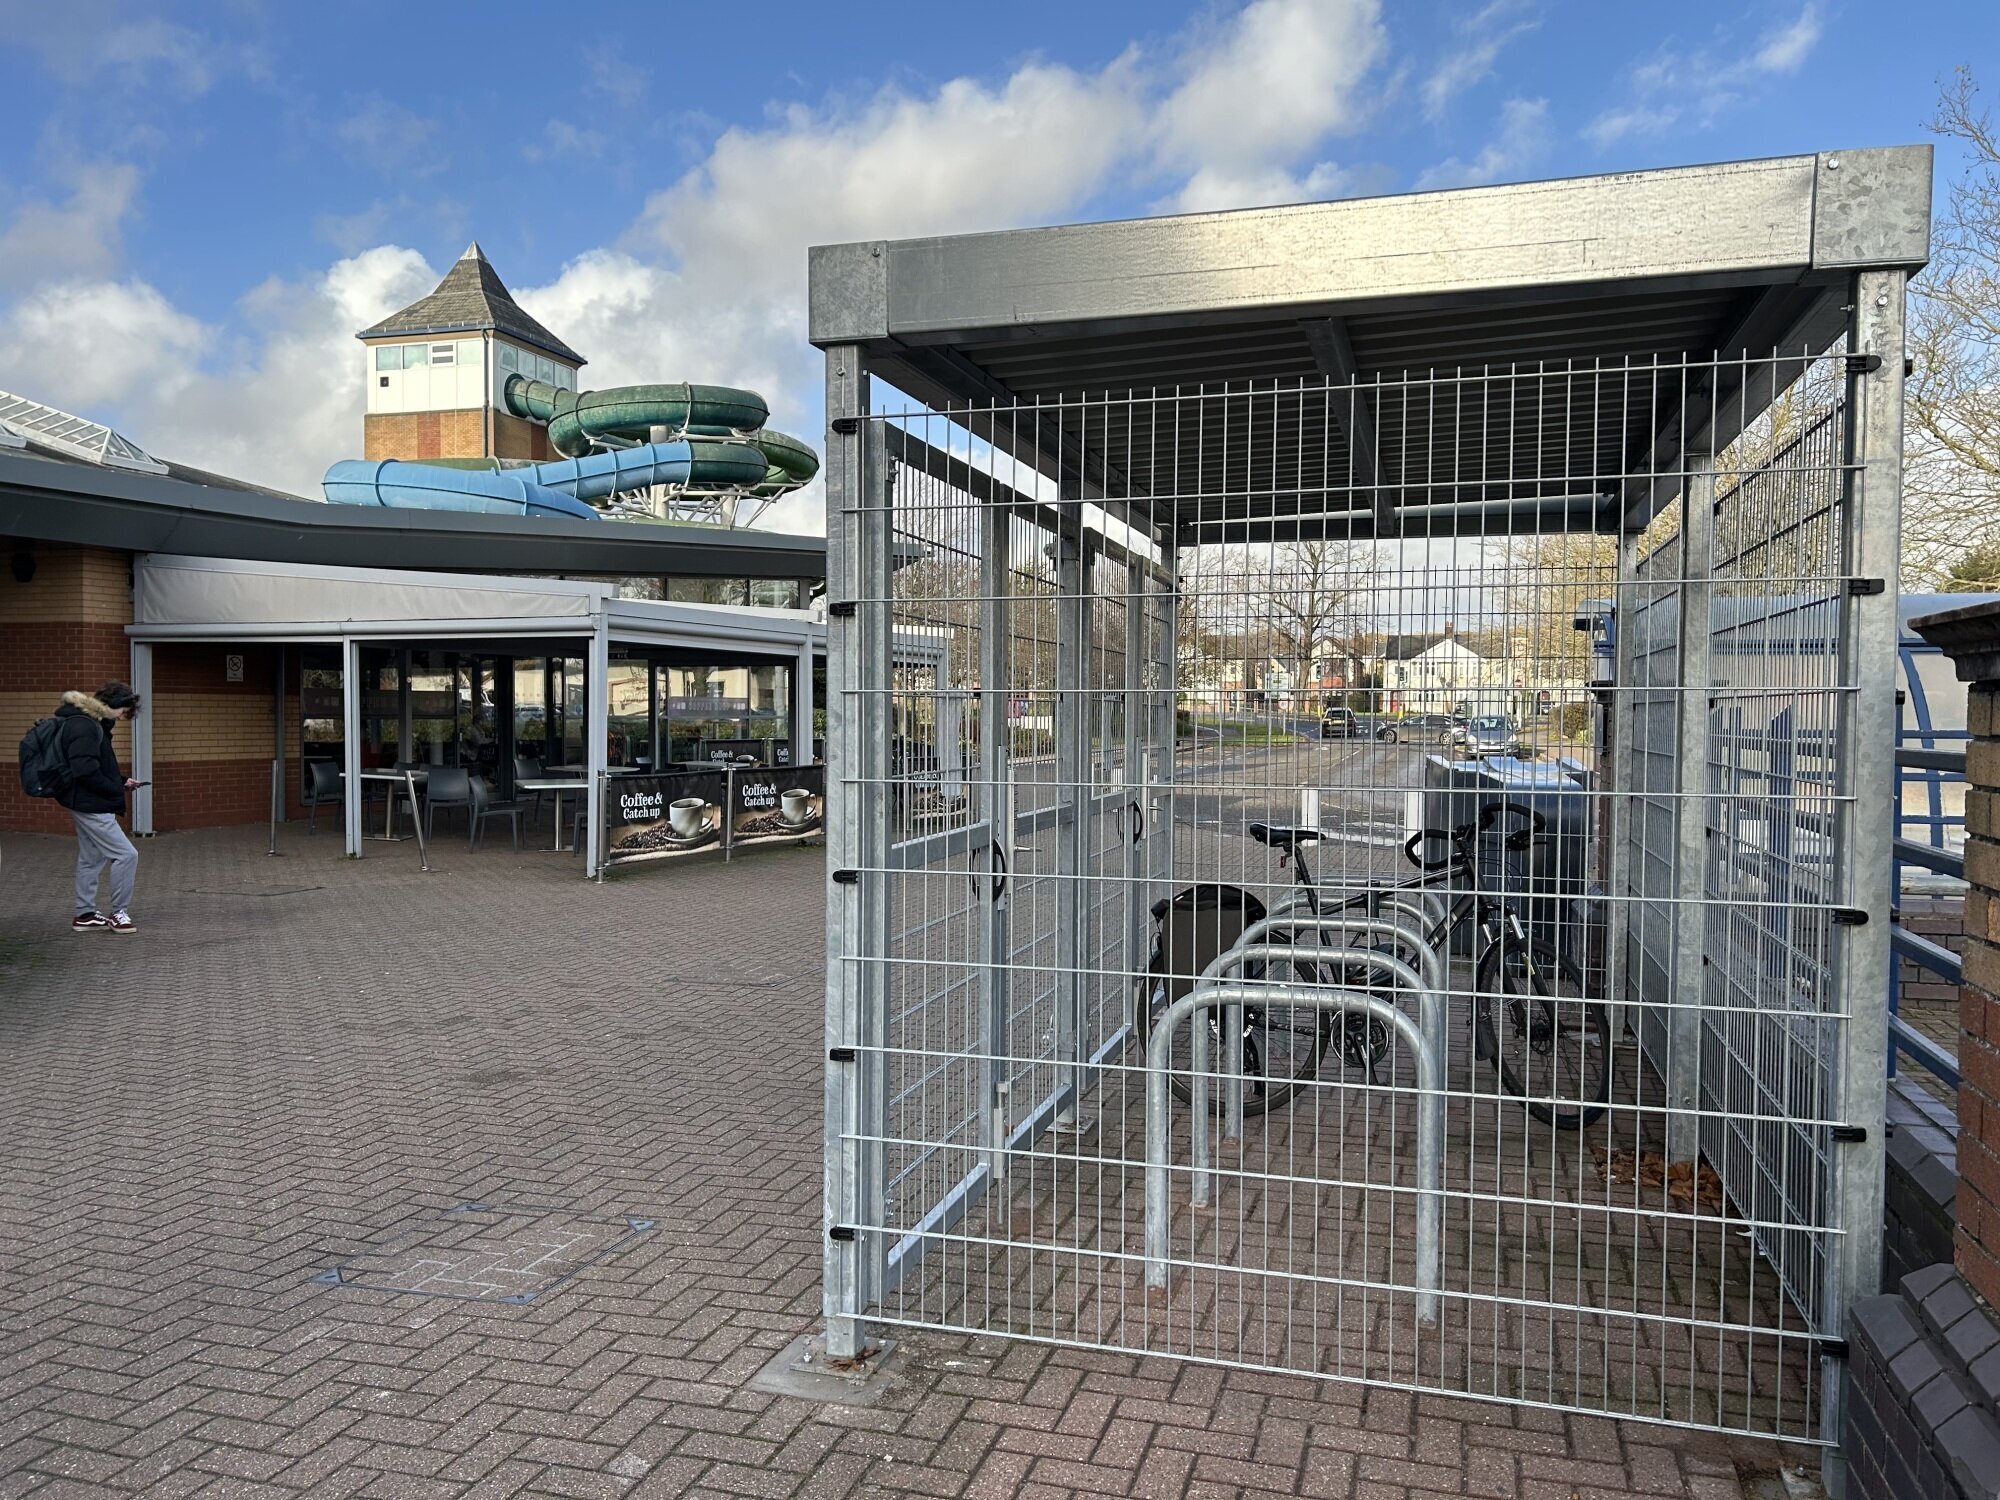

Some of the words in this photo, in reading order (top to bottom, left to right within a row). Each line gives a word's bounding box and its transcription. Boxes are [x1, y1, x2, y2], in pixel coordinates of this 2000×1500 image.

[711, 750, 728, 758] Coffee
[742, 784, 769, 797] Coffee
[769, 783, 777, 795] &
[620, 792, 654, 808] Coffee
[654, 791, 663, 805] &
[744, 796, 765, 807] Catch
[765, 797, 775, 807] up
[623, 806, 649, 819] Catch
[649, 807, 660, 819] up
